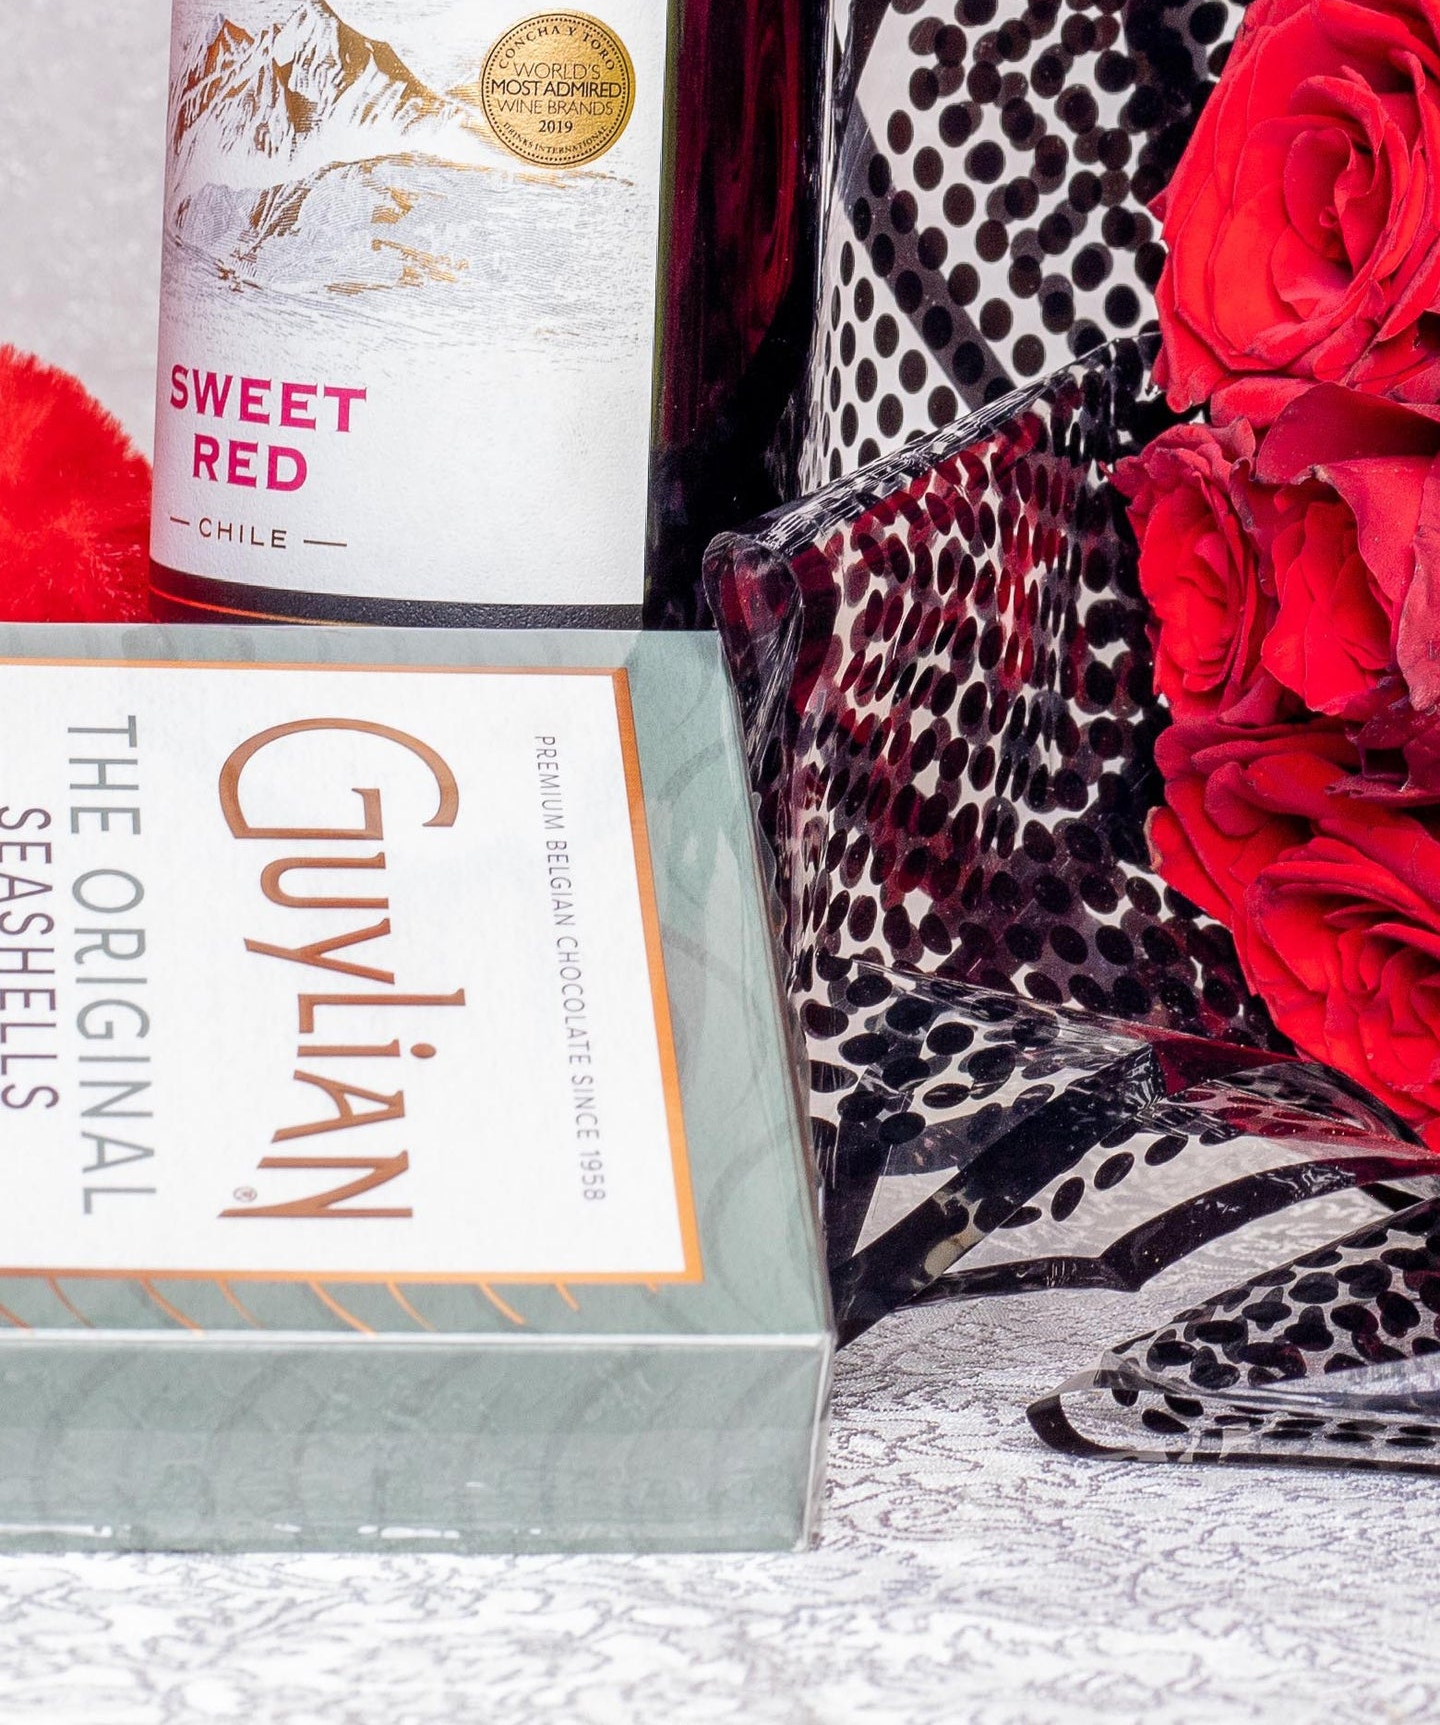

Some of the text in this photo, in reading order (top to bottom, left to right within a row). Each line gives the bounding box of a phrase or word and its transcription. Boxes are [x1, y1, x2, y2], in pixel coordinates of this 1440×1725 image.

[498, 25, 615, 71] CONCHA Y TORO
[491, 78, 622, 98] MOST ADMIRED
[513, 62, 601, 80] WORLD'S
[496, 98, 614, 116] WINE BRANDS
[502, 121, 608, 155] DRINKS INTERNATIONAL
[538, 119, 574, 134] 2019
[170, 363, 368, 433] SWEET
[192, 432, 308, 492] RED
[198, 517, 287, 550] CHILE
[66, 714, 158, 1216] THE ORIGINAL
[534, 735, 606, 1201] PREMIUM BELGIAN CHOCOLATE SINCE 1958
